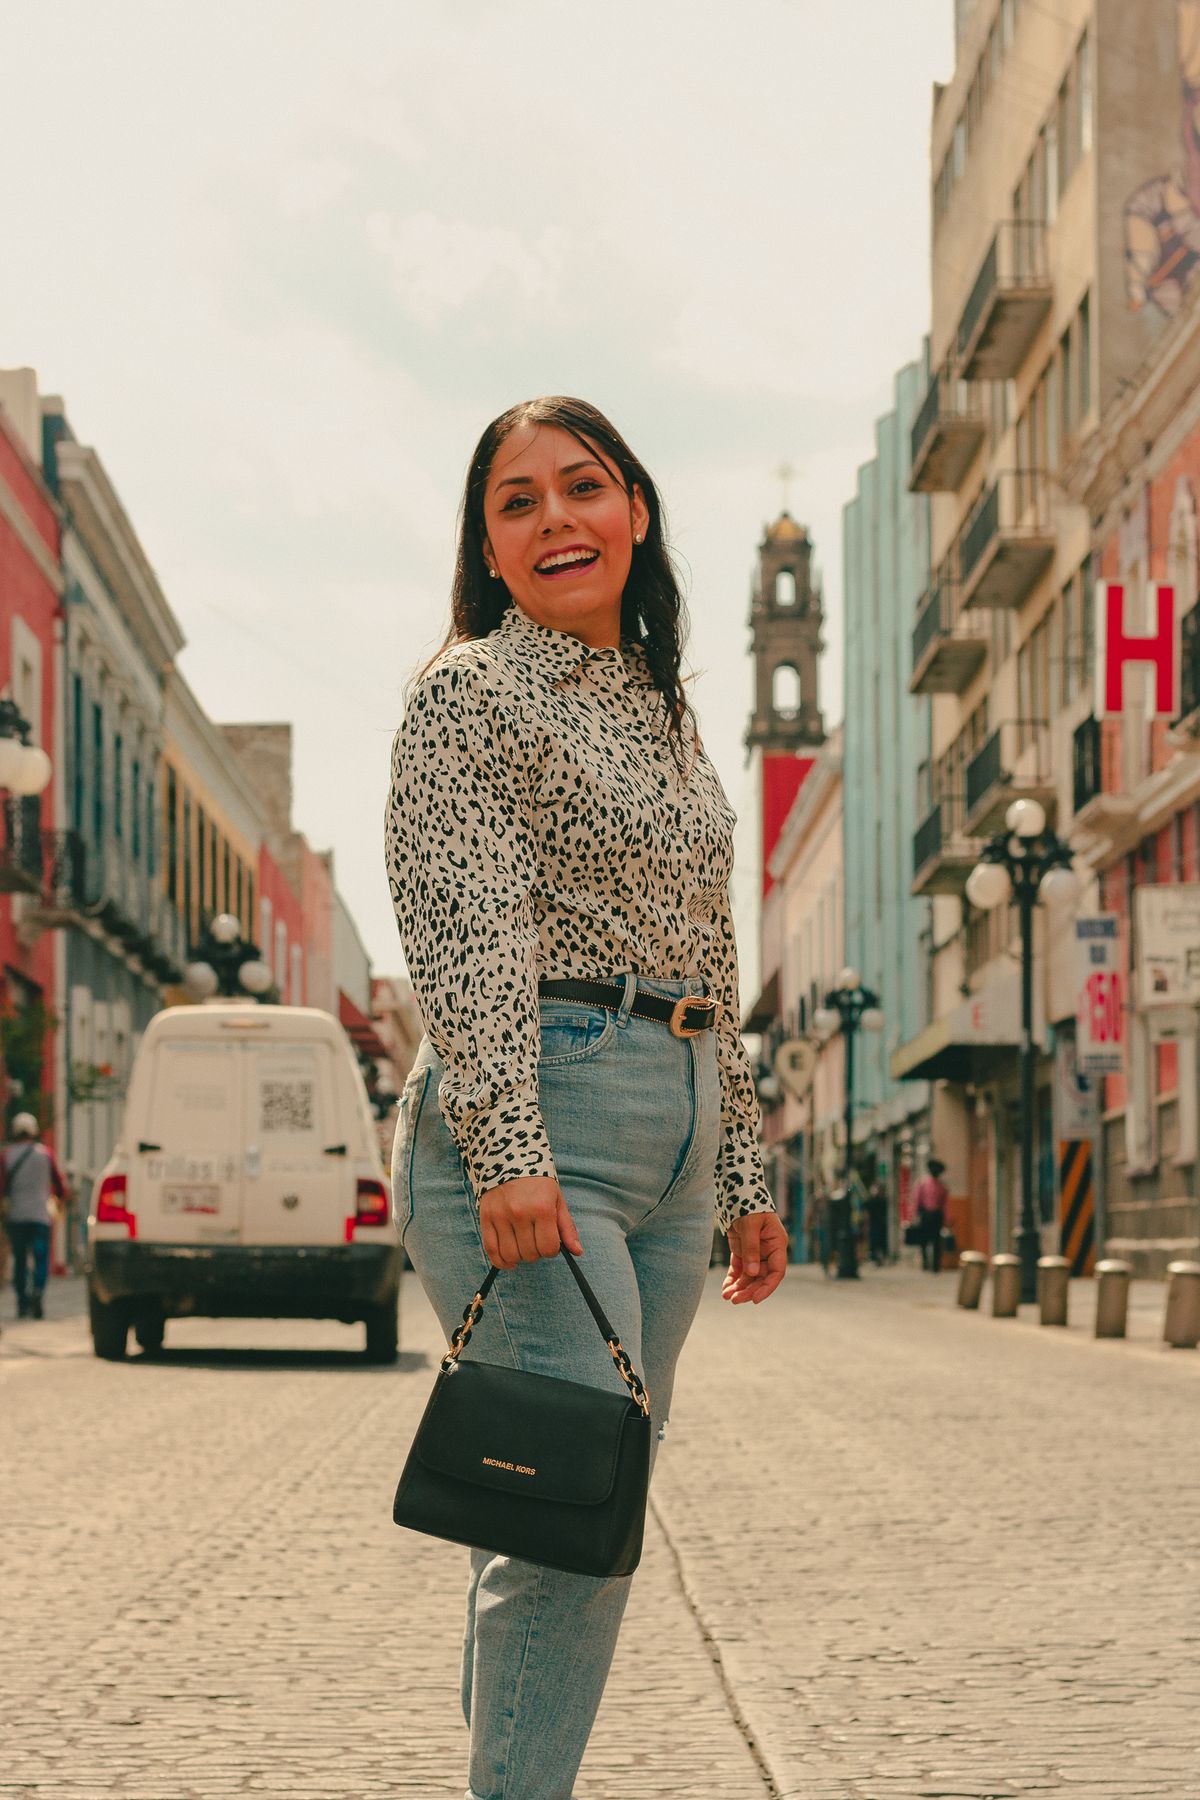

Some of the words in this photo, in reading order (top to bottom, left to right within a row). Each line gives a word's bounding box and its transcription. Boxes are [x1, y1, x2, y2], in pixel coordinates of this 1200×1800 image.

[1103, 584, 1176, 714] H
[482, 1457, 514, 1471] MICHAEL
[515, 1464, 536, 1476] KORS
